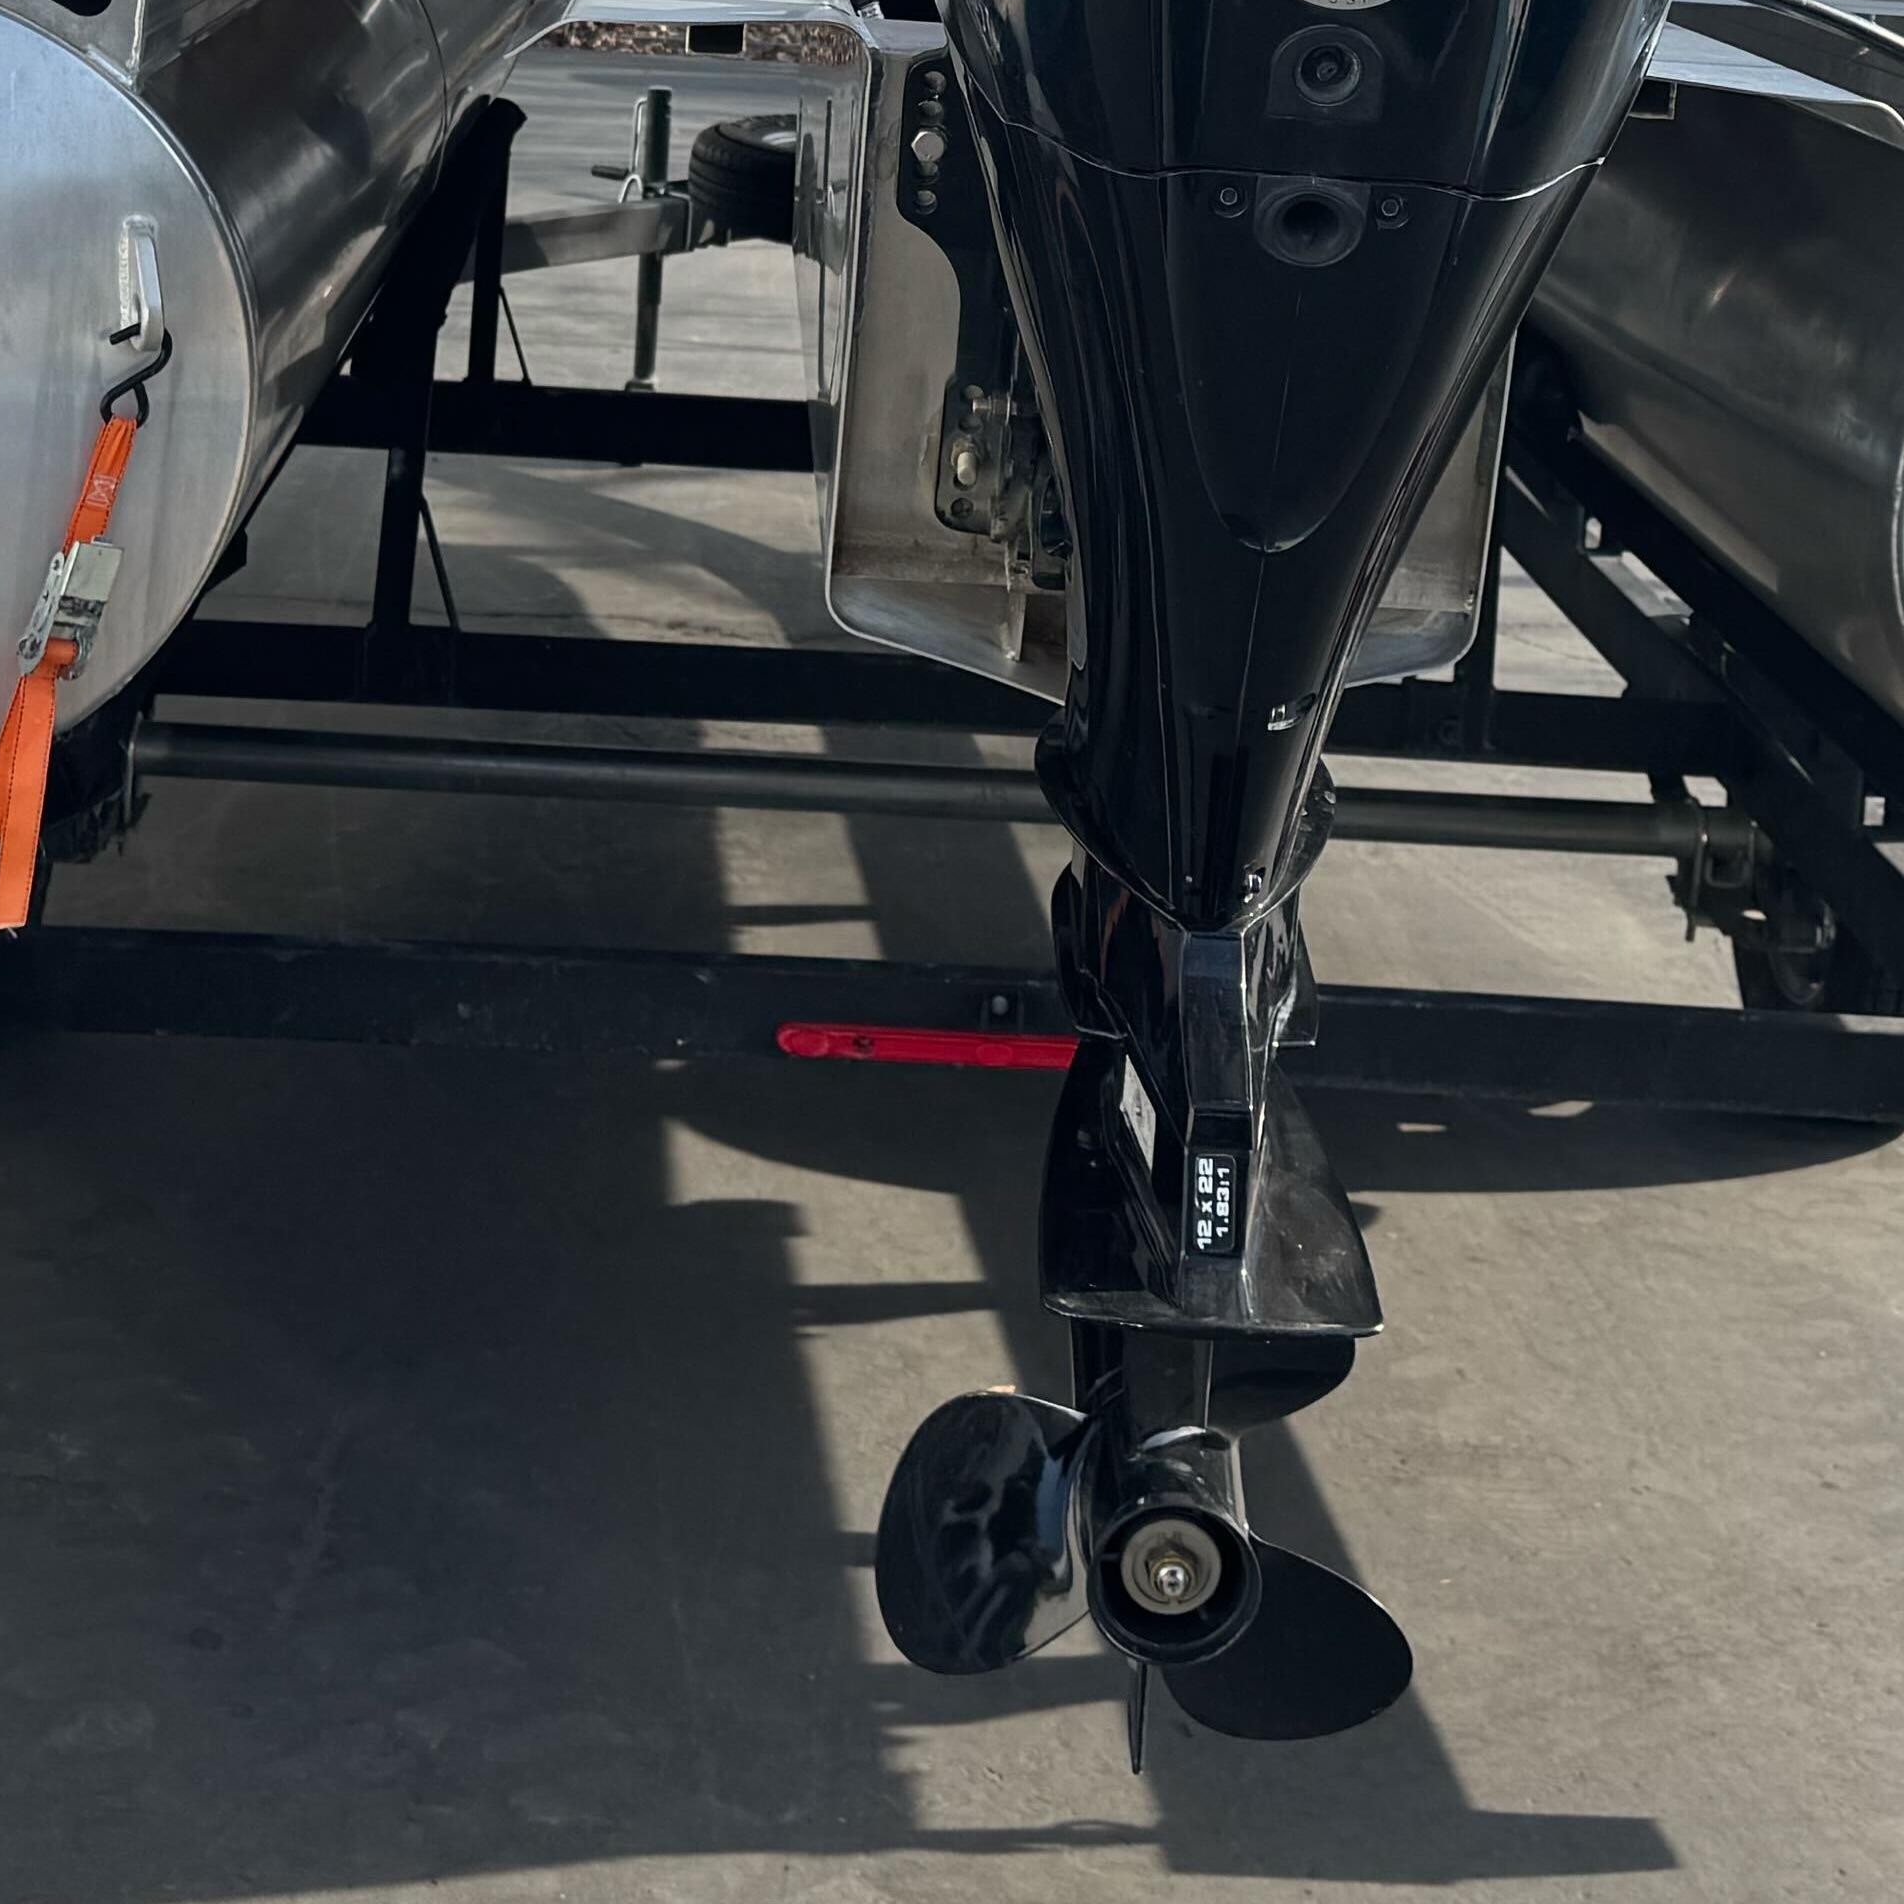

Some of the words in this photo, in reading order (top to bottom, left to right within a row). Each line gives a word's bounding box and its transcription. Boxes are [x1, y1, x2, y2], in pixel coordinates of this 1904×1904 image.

[1198, 1158, 1214, 1194] 22
[1216, 1168, 1230, 1237] 1.83:1
[1197, 1220, 1212, 1250] 12
